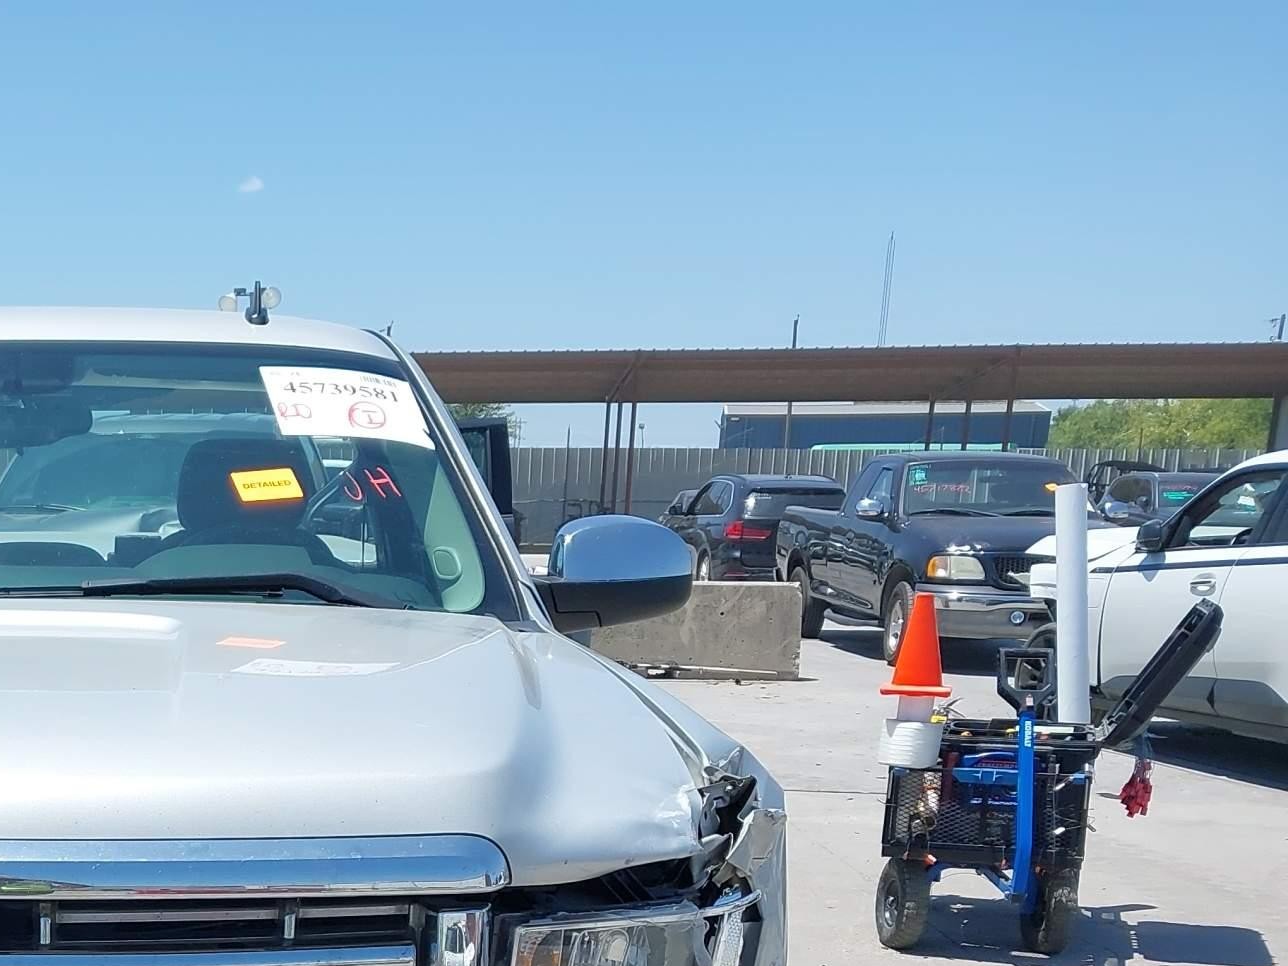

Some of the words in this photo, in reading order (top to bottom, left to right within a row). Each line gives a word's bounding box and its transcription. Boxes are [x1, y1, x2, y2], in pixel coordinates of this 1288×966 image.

[283, 381, 399, 402] 45739581
[242, 479, 292, 490] DETAILED
[1024, 720, 1032, 747] KOBALT
